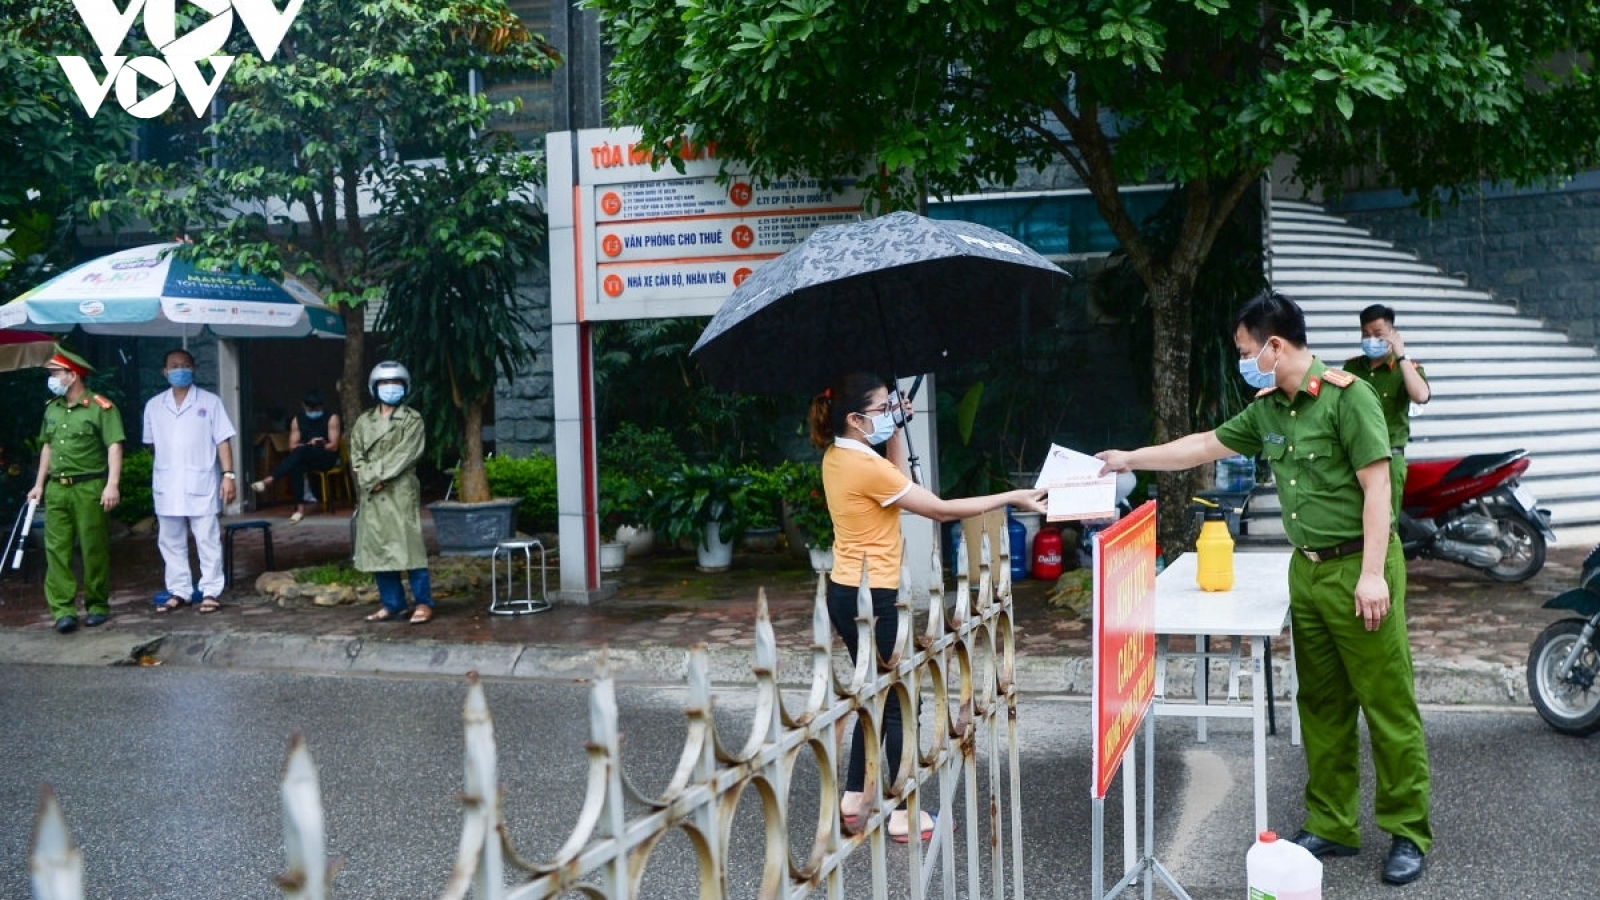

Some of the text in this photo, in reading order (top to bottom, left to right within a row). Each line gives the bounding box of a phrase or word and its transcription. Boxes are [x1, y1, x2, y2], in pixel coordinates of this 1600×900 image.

[589, 141, 624, 169] TÒA
[624, 229, 722, 249] VĂN PHÒNG CHO THUÊ
[236, 279, 257, 287] 4G
[627, 274, 642, 288] NHÀ
[643, 275, 653, 288] XE
[655, 272, 670, 287] CÁN
[686, 271, 707, 285] NHÂN
[708, 270, 726, 284] VIÊN
[1118, 632, 1137, 695] CÁCH
